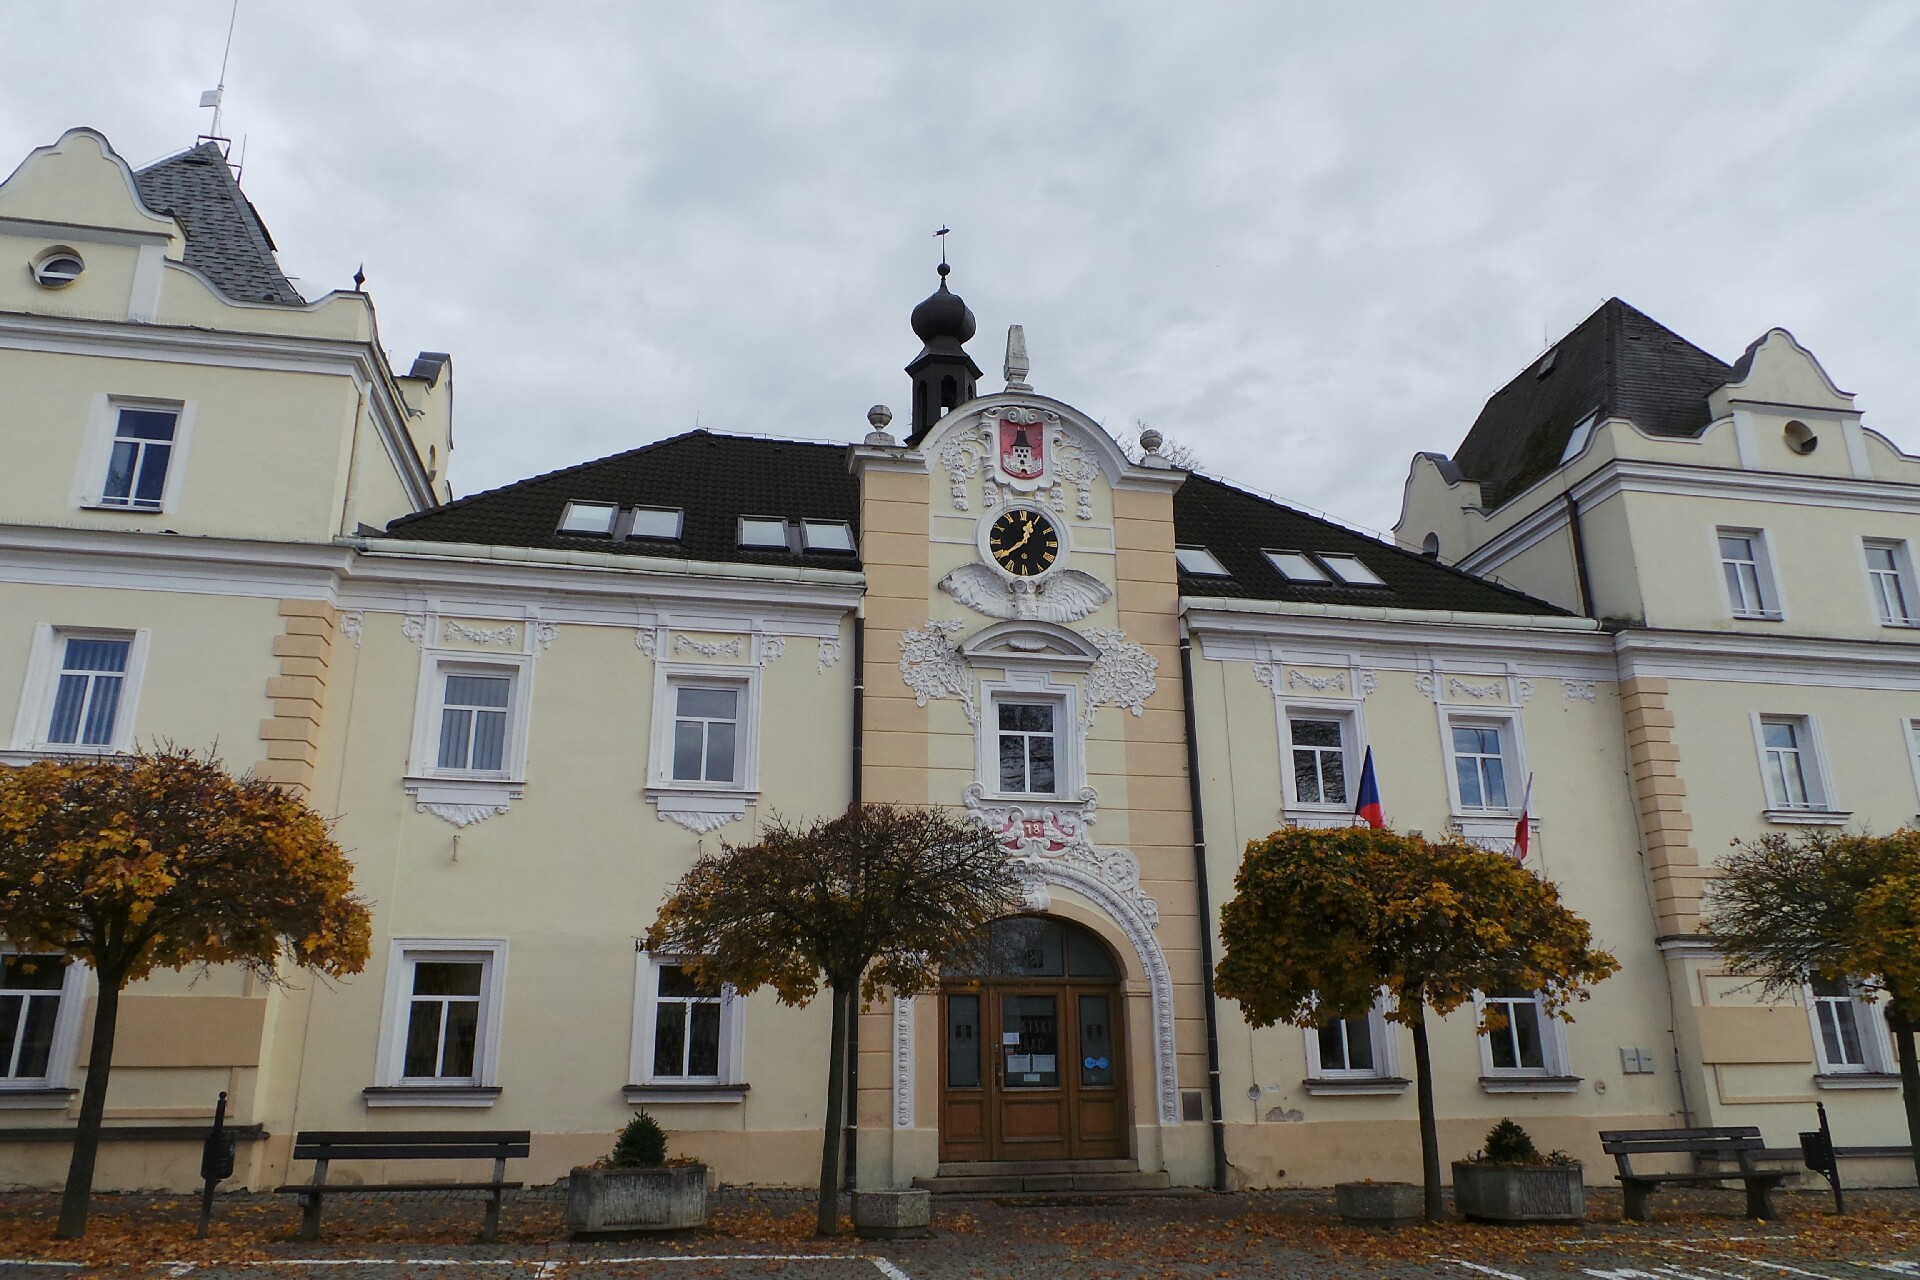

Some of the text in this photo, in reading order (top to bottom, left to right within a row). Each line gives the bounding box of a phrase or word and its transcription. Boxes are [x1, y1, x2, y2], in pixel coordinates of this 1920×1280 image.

[994, 523, 1005, 533] X
[1025, 824, 1040, 835] 18
[1007, 1017, 1053, 1033] STSKÝ
